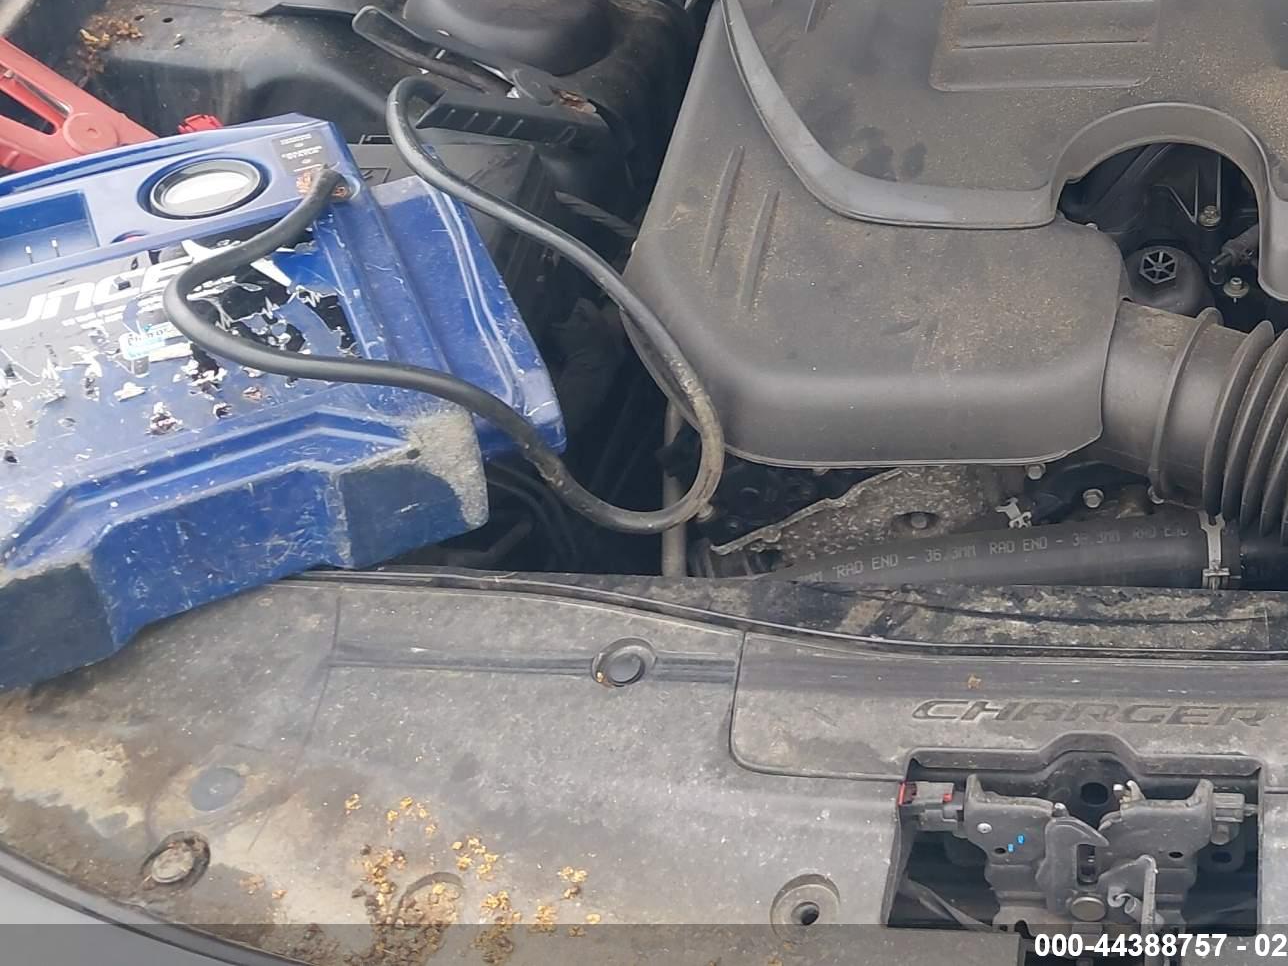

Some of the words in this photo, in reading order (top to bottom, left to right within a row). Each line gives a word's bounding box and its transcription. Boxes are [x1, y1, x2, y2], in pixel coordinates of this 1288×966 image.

[872, 553, 899, 571] END
[989, 541, 1016, 555] RAD
[1023, 536, 1048, 552] END
[911, 699, 1269, 727] CHARGER
